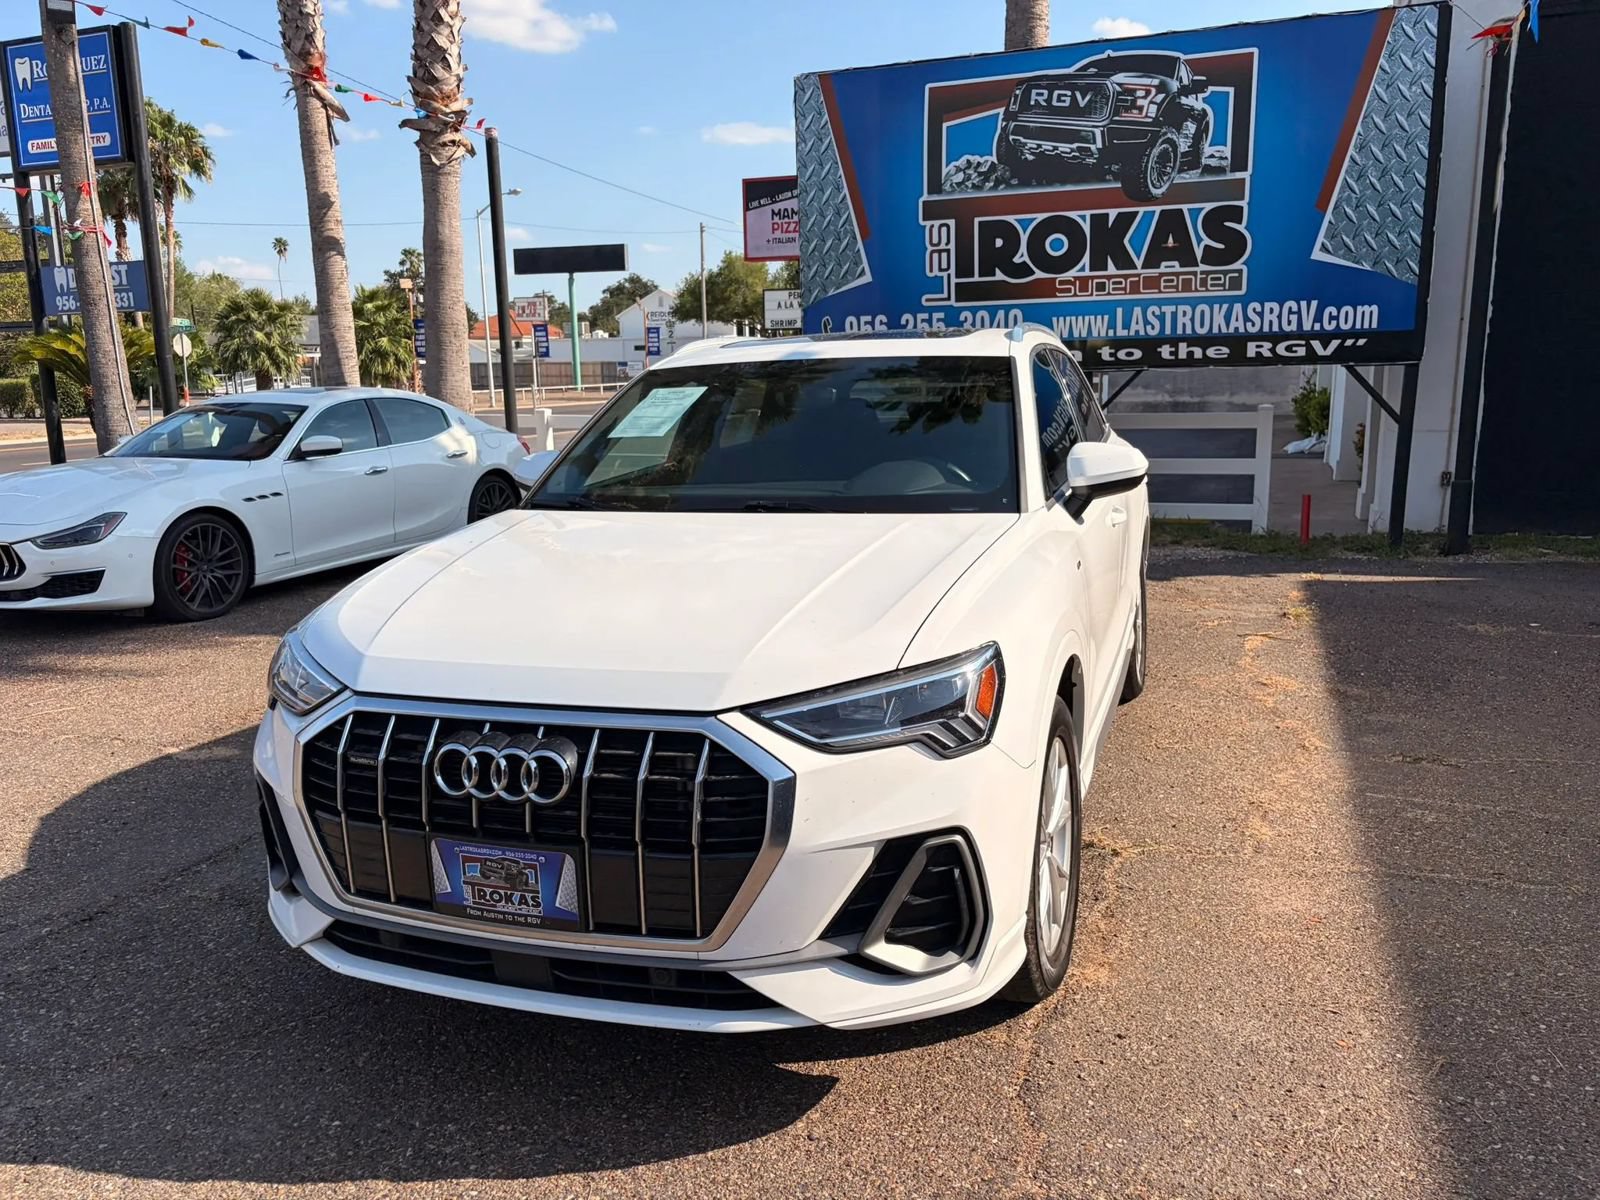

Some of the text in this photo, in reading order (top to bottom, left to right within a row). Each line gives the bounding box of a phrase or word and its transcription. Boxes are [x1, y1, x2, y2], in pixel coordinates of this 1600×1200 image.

[1030, 89, 1093, 108] RGV
[20, 102, 53, 118] DENTA
[921, 198, 1250, 281] TROKAS
[1055, 271, 1239, 298] SuperCenter
[770, 319, 798, 328] SHRIMP
[1052, 300, 1379, 338] www.LASTROKASRGV.com
[1097, 343, 1143, 362] to
[1157, 341, 1231, 360] the
[486, 861, 502, 869] RGV
[464, 883, 543, 909] TROKAS
